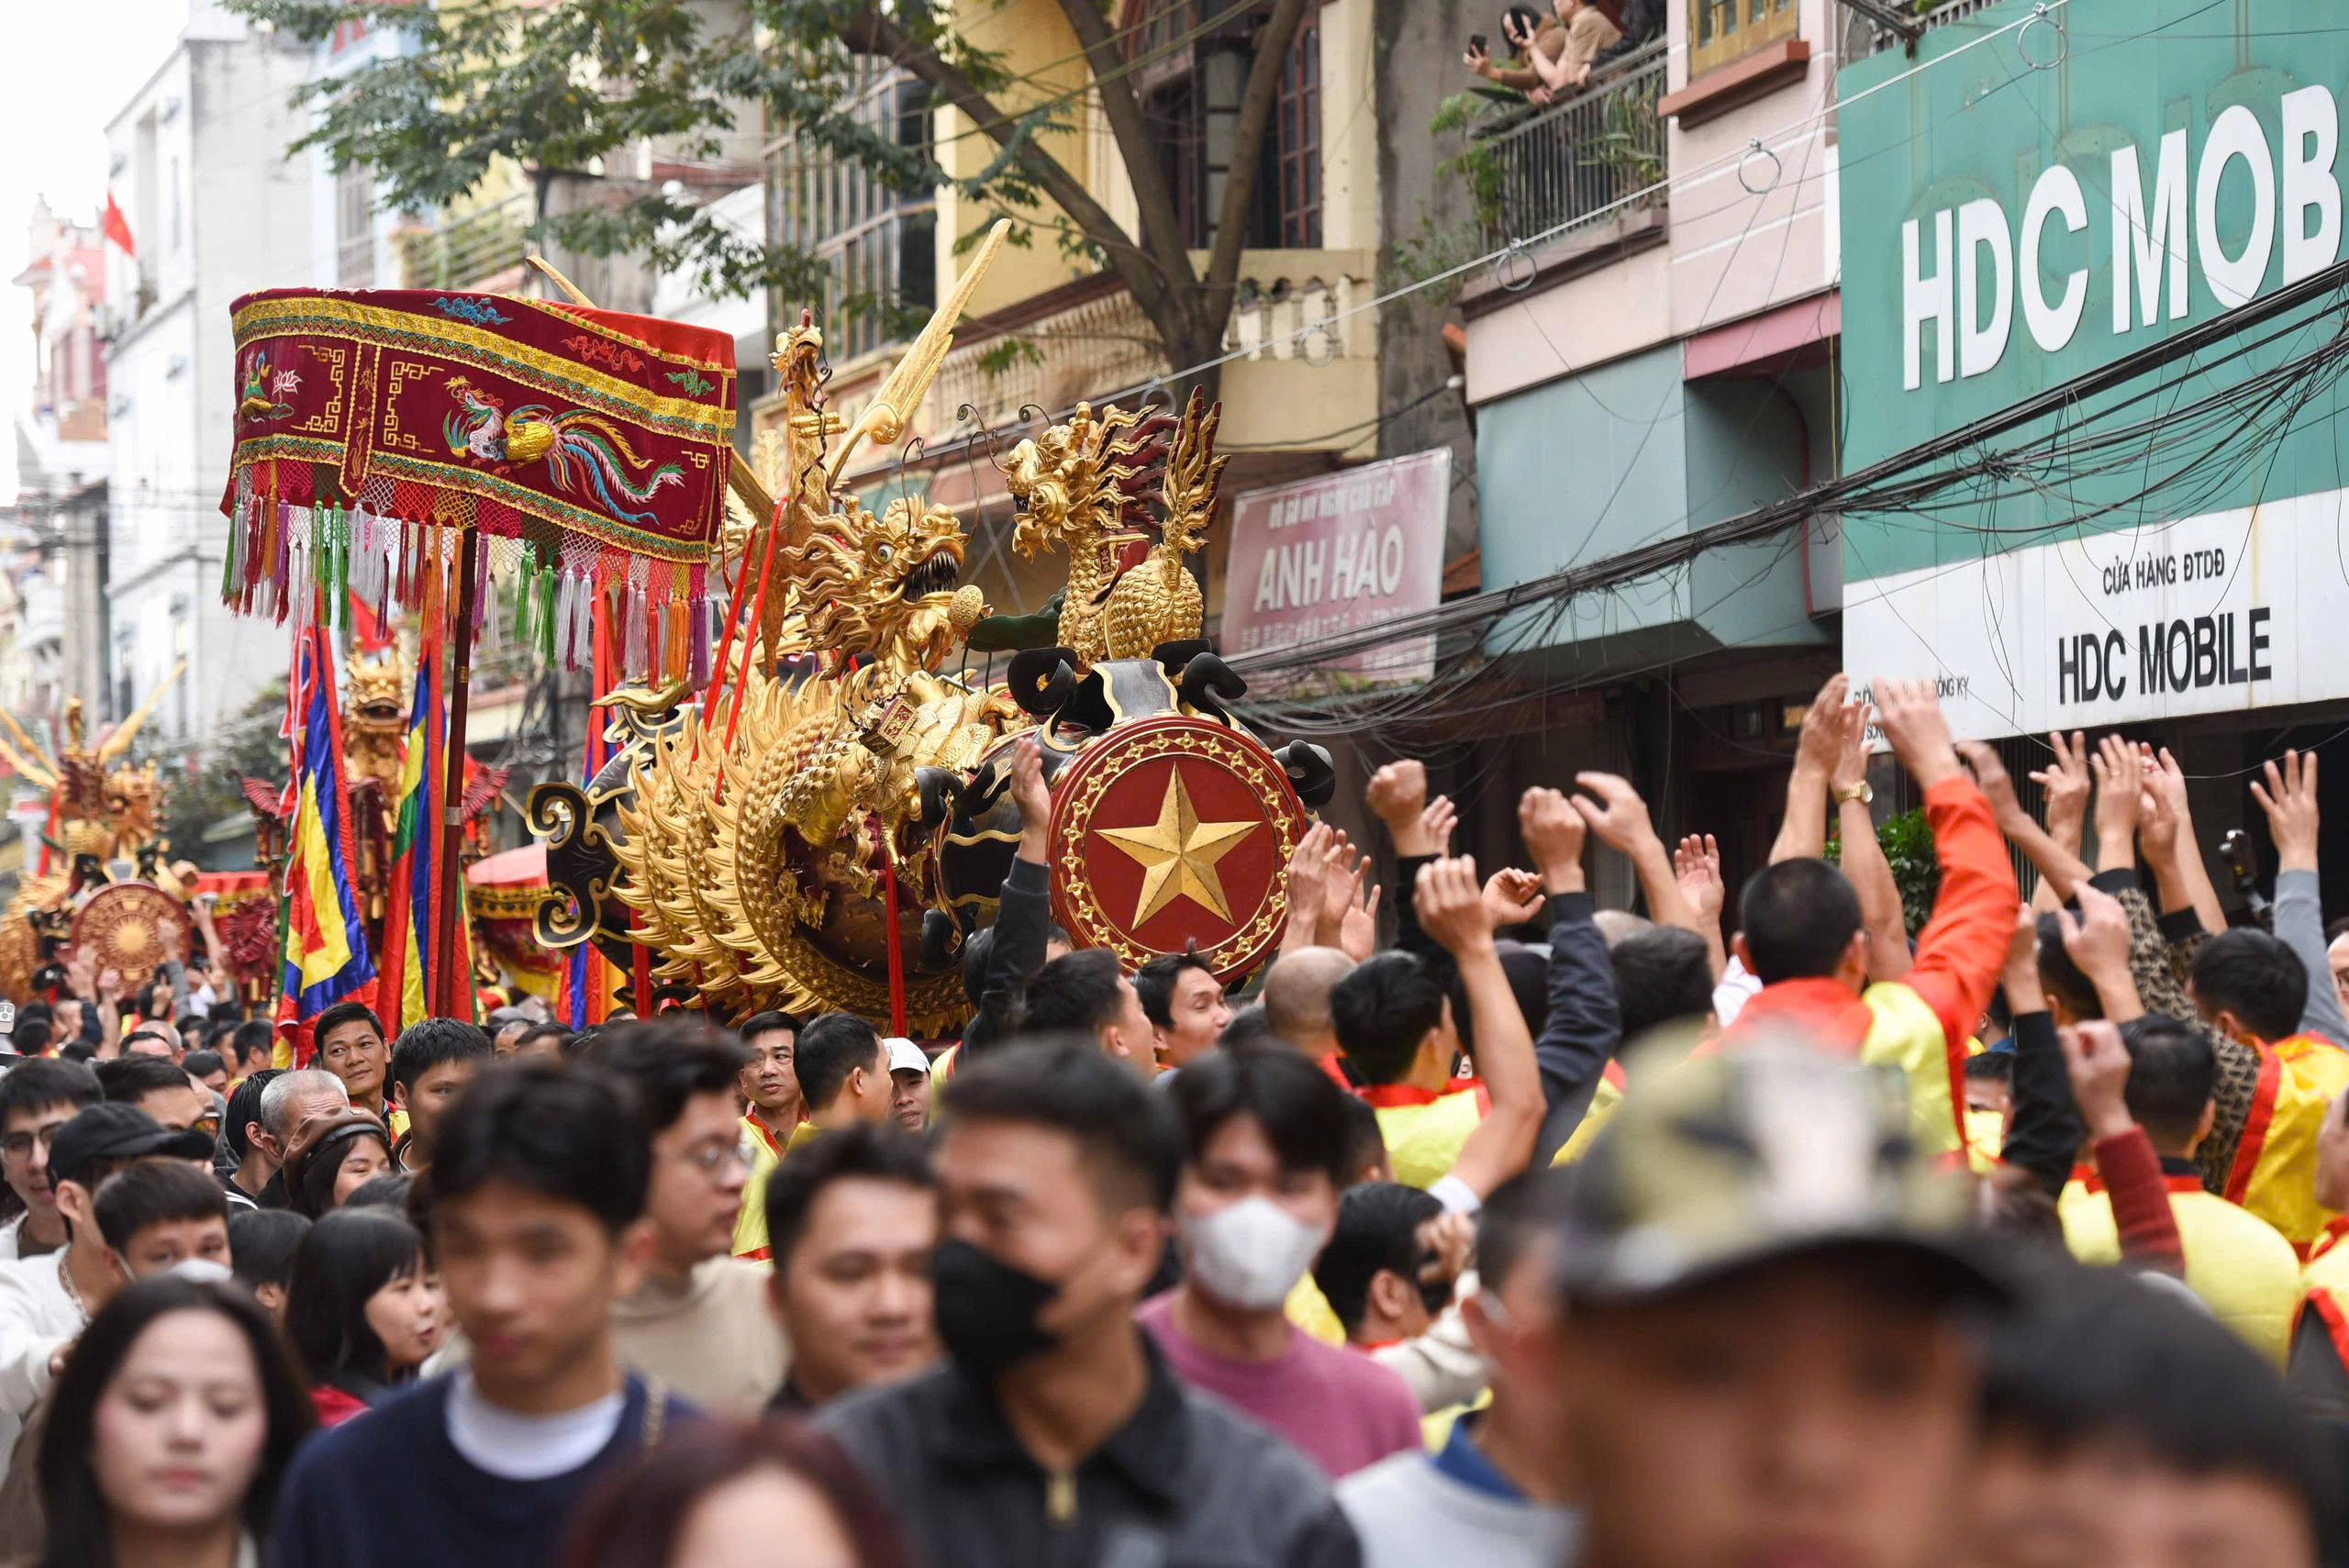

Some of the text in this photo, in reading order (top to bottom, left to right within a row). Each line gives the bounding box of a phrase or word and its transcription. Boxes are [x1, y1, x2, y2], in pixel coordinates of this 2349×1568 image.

[1902, 84, 2343, 392] HDC MOB
[1253, 539, 1326, 613] ANH
[2103, 549, 2225, 595] CỬA HÀNG ĐTDĐ
[2059, 606, 2271, 705] HDC MOBILE
